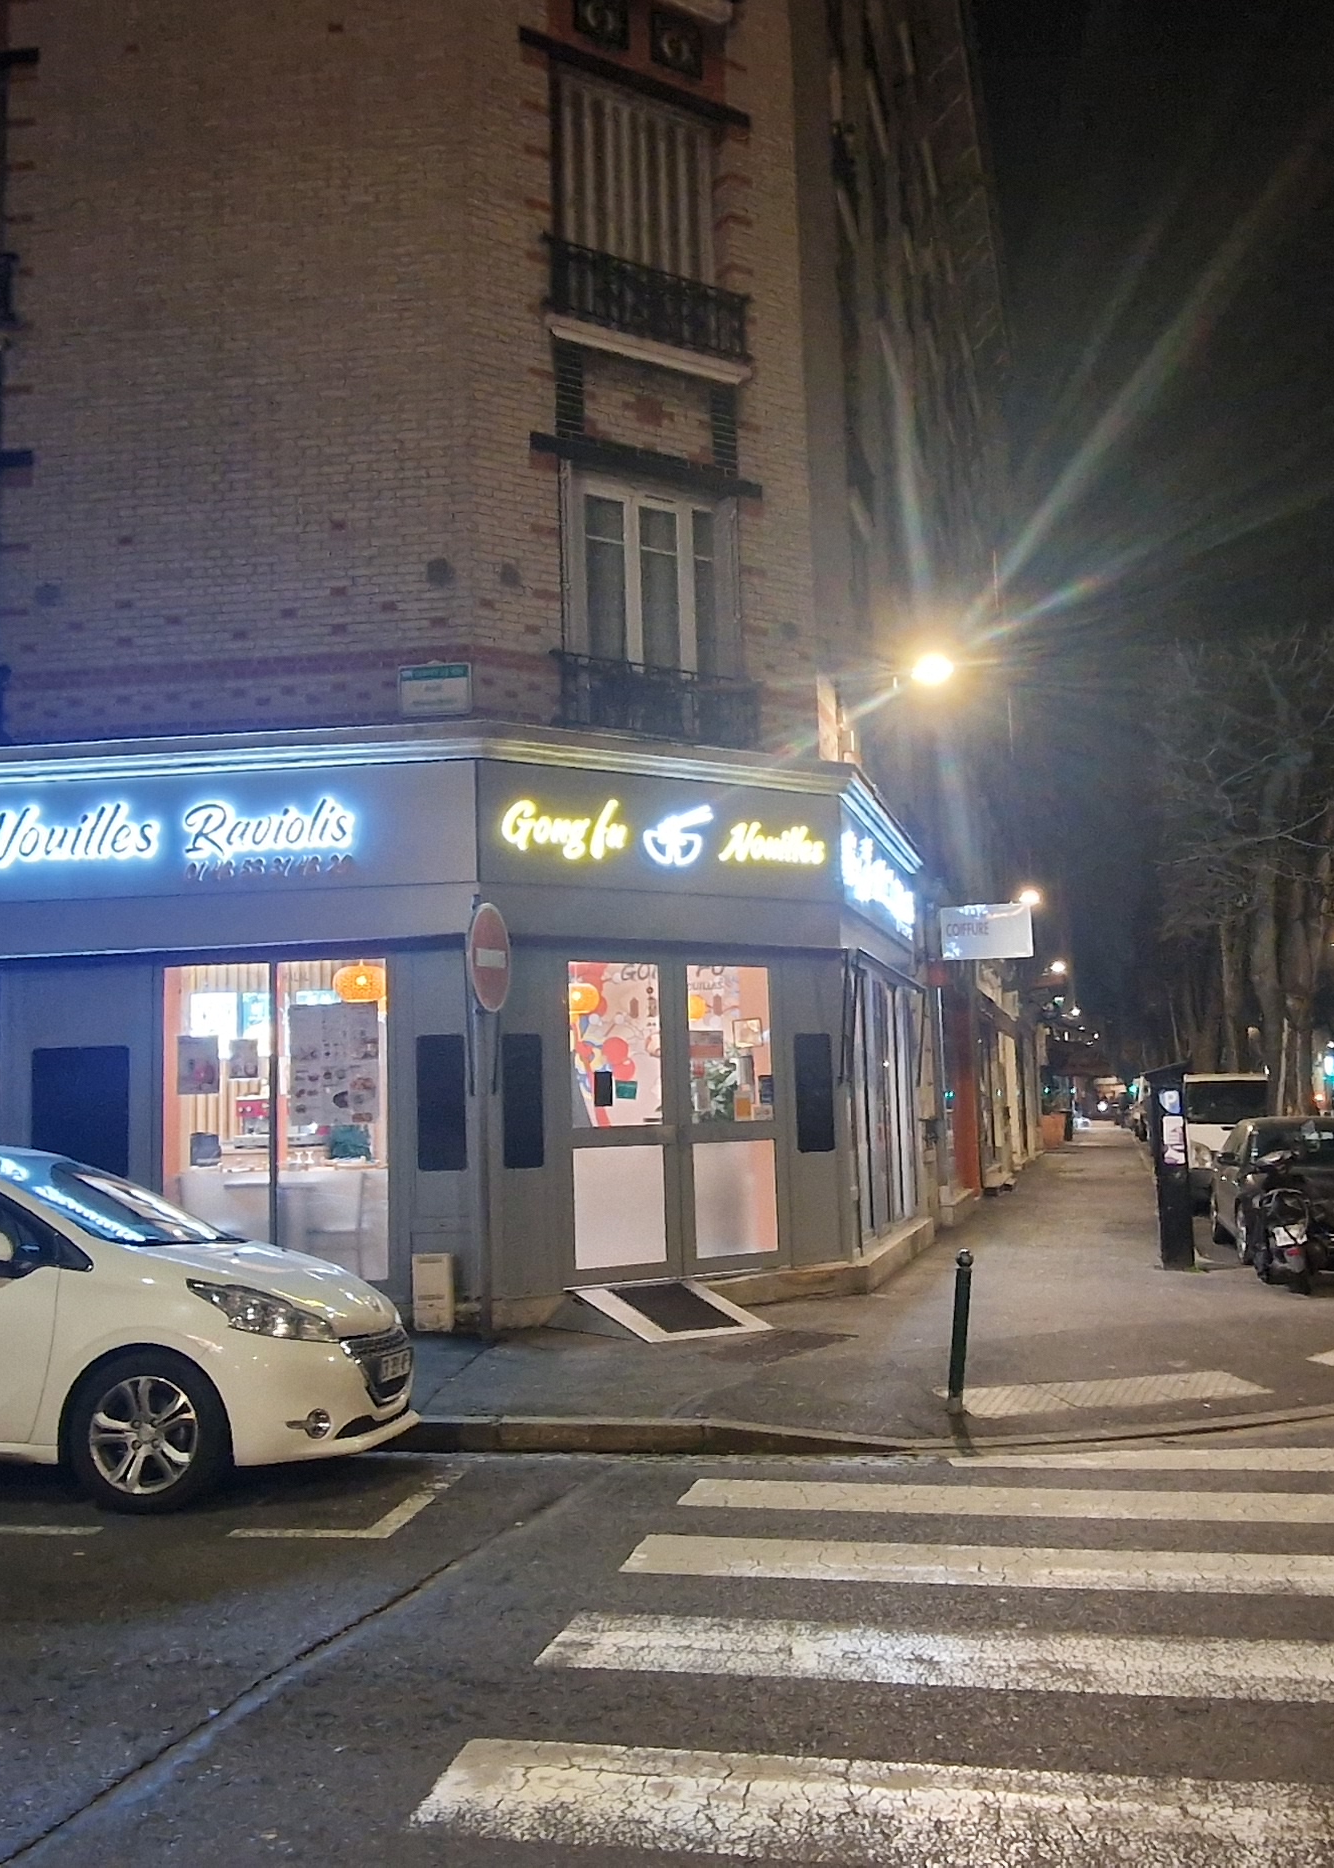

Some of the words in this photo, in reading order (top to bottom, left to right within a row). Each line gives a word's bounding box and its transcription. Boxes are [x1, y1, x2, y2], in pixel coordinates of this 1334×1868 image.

[183, 797, 353, 857] Raviolis
[501, 799, 592, 860] Gong
[589, 798, 628, 860] fu
[718, 821, 825, 865] Nouilles
[945, 921, 990, 938] COIFFURE
